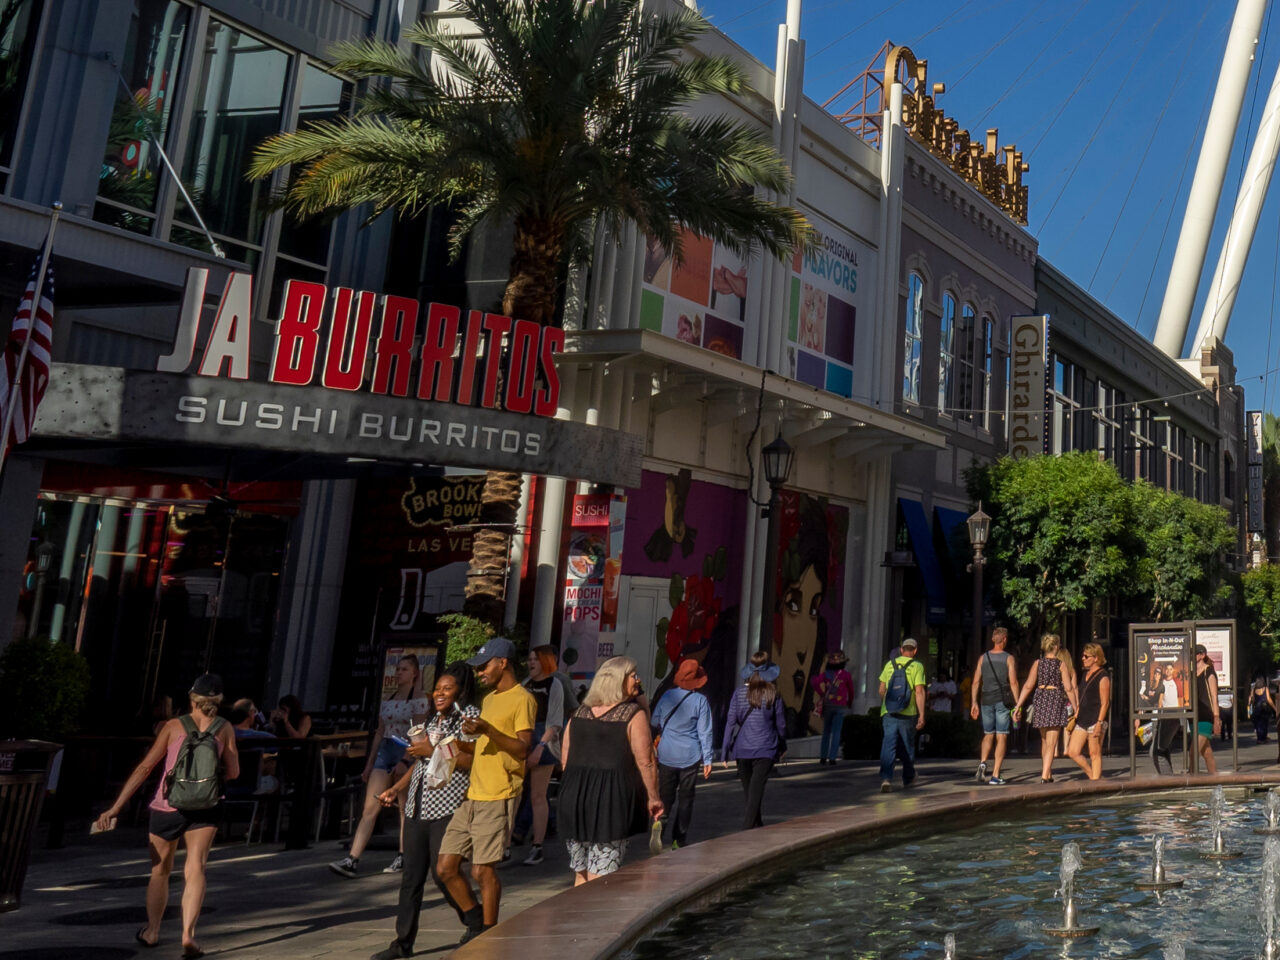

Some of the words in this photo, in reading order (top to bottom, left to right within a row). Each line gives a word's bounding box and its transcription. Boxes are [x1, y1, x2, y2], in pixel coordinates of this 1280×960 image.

[824, 235, 858, 267] ORIGINAL
[1013, 323, 1041, 460] Ghirarde
[176, 394, 337, 435] SUSHI
[358, 413, 541, 456] BURRITOS
[412, 483, 481, 513] BROOK
[575, 504, 609, 516] SUSHI
[408, 539, 441, 552] LAS
[566, 587, 601, 599] MOCHI
[565, 606, 600, 621] POPS
[1148, 637, 1162, 646] Shop
[598, 643, 615, 657] BEER
